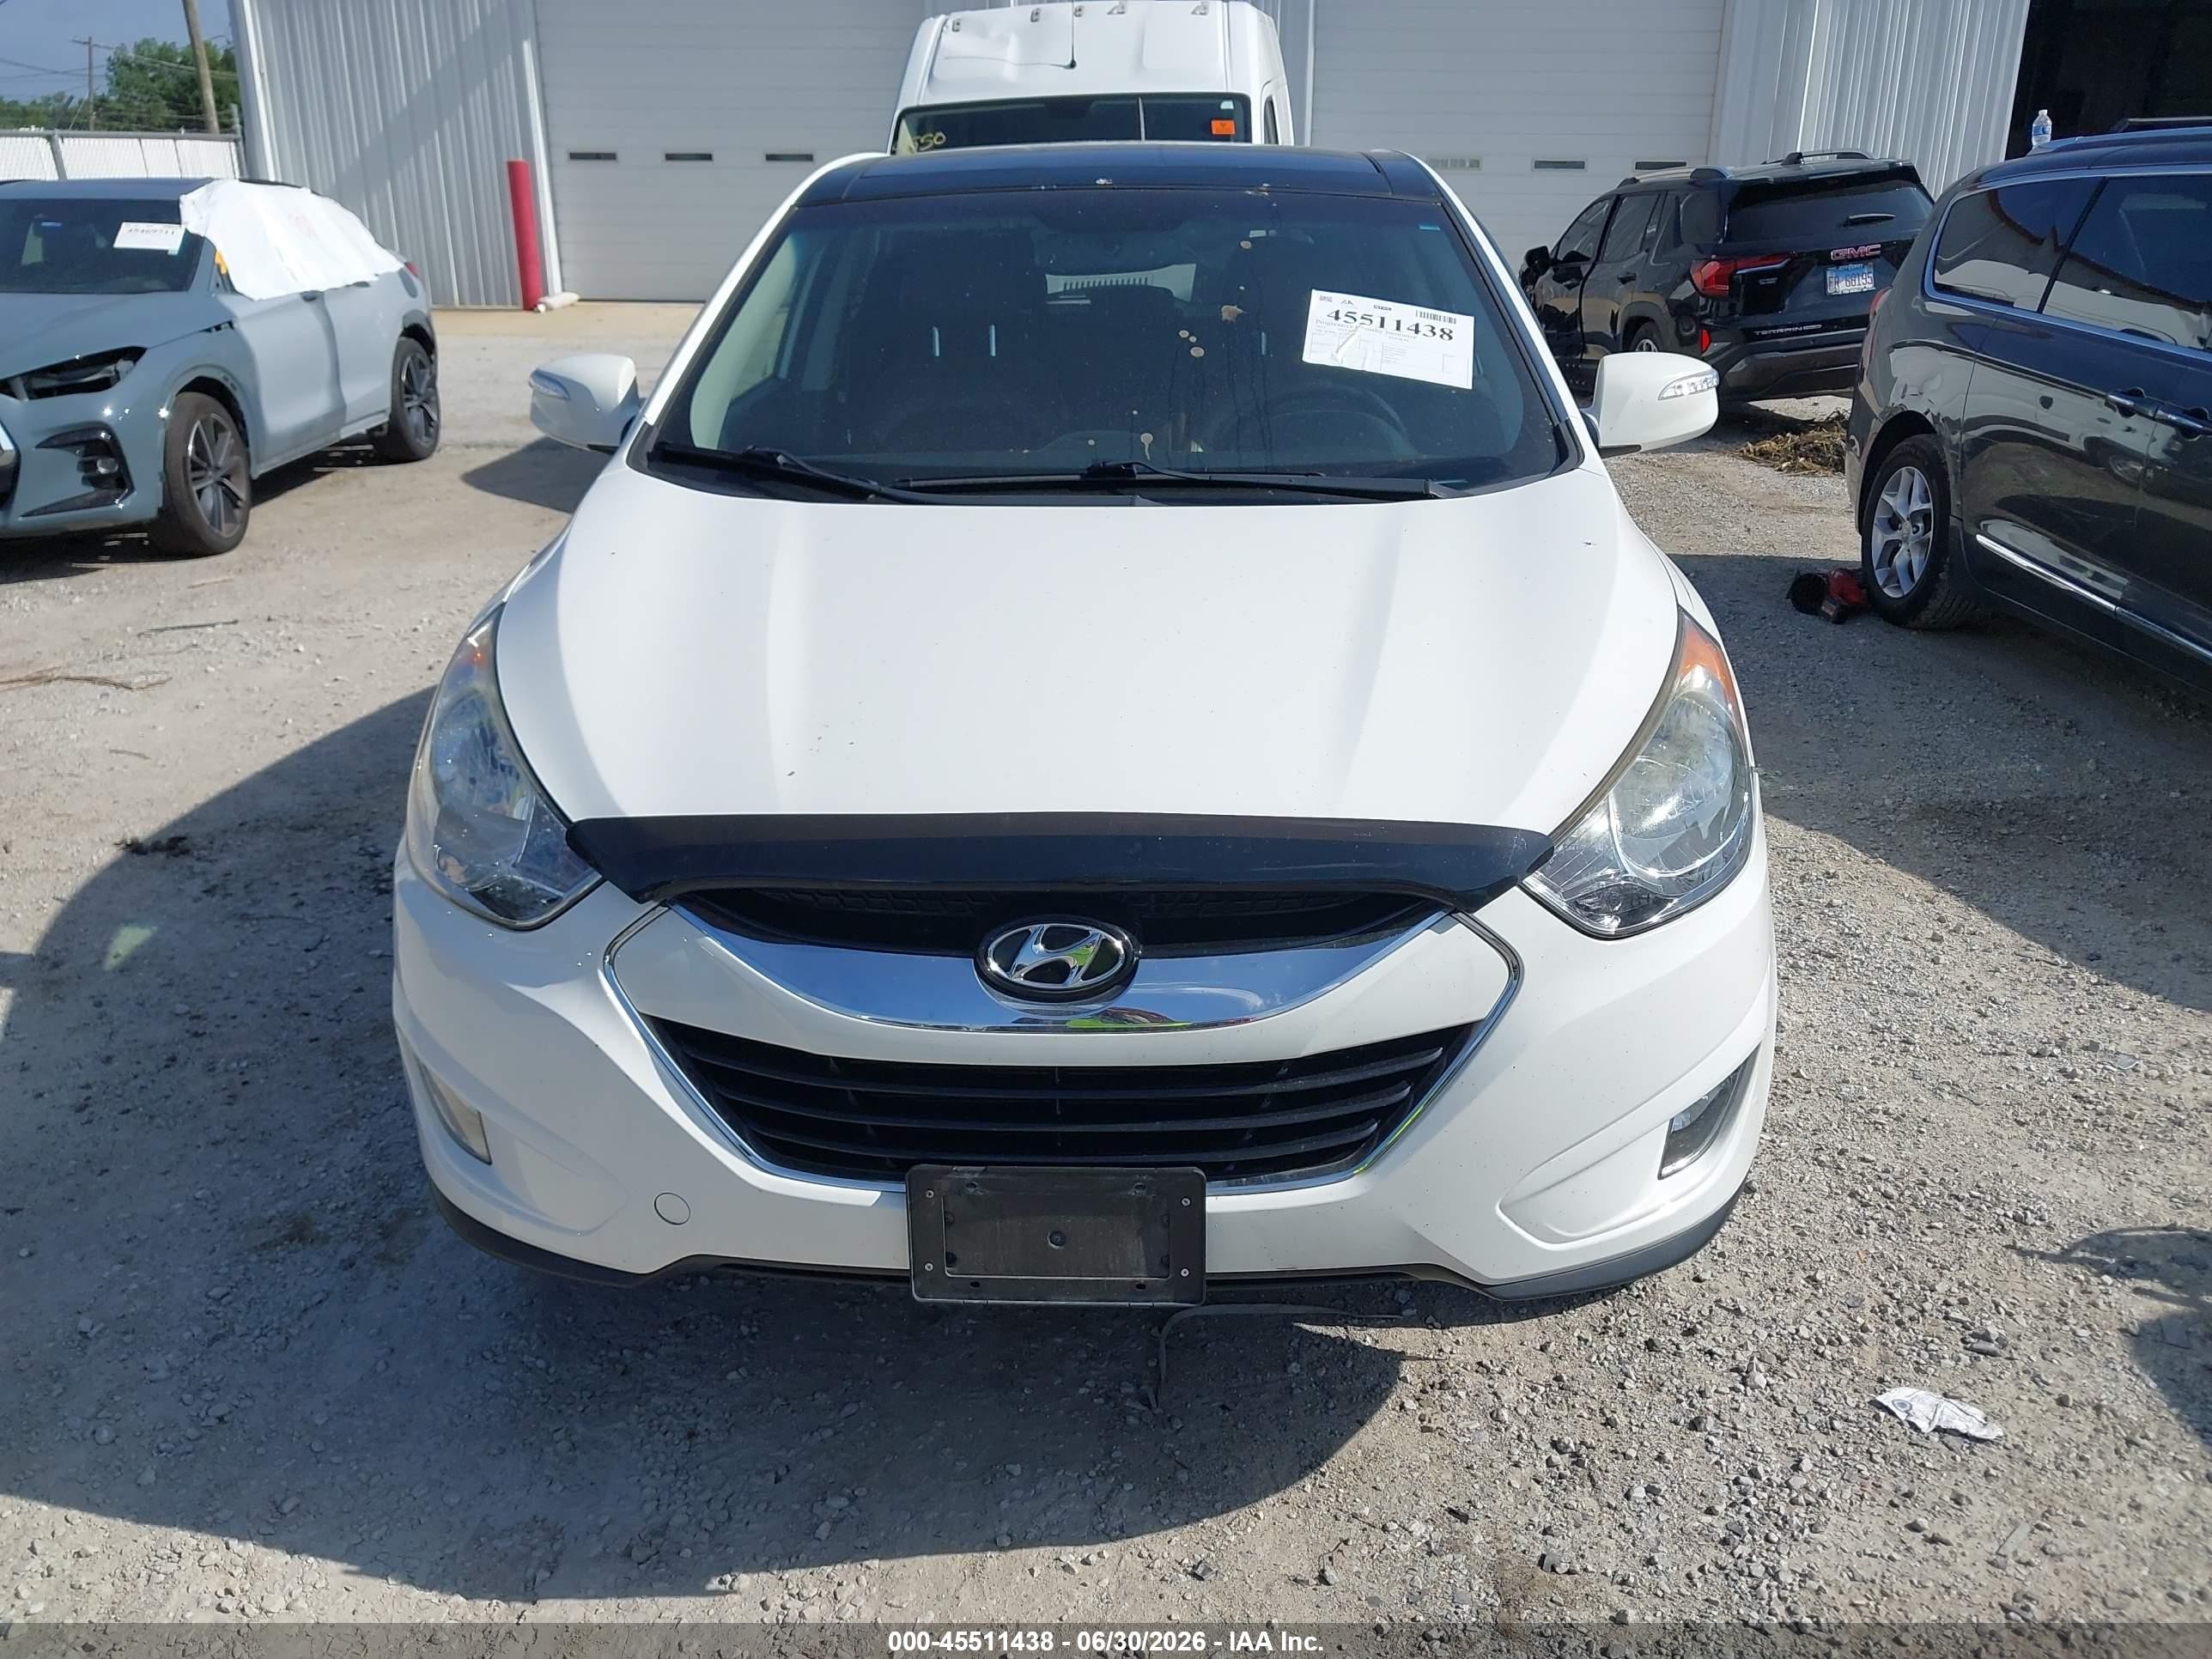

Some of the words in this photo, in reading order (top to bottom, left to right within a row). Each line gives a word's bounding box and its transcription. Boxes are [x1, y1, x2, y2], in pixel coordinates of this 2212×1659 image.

[1831, 244, 1881, 260] GMC
[1327, 309, 1454, 342] 45511438
[1753, 326, 1803, 336] TERRAIN
